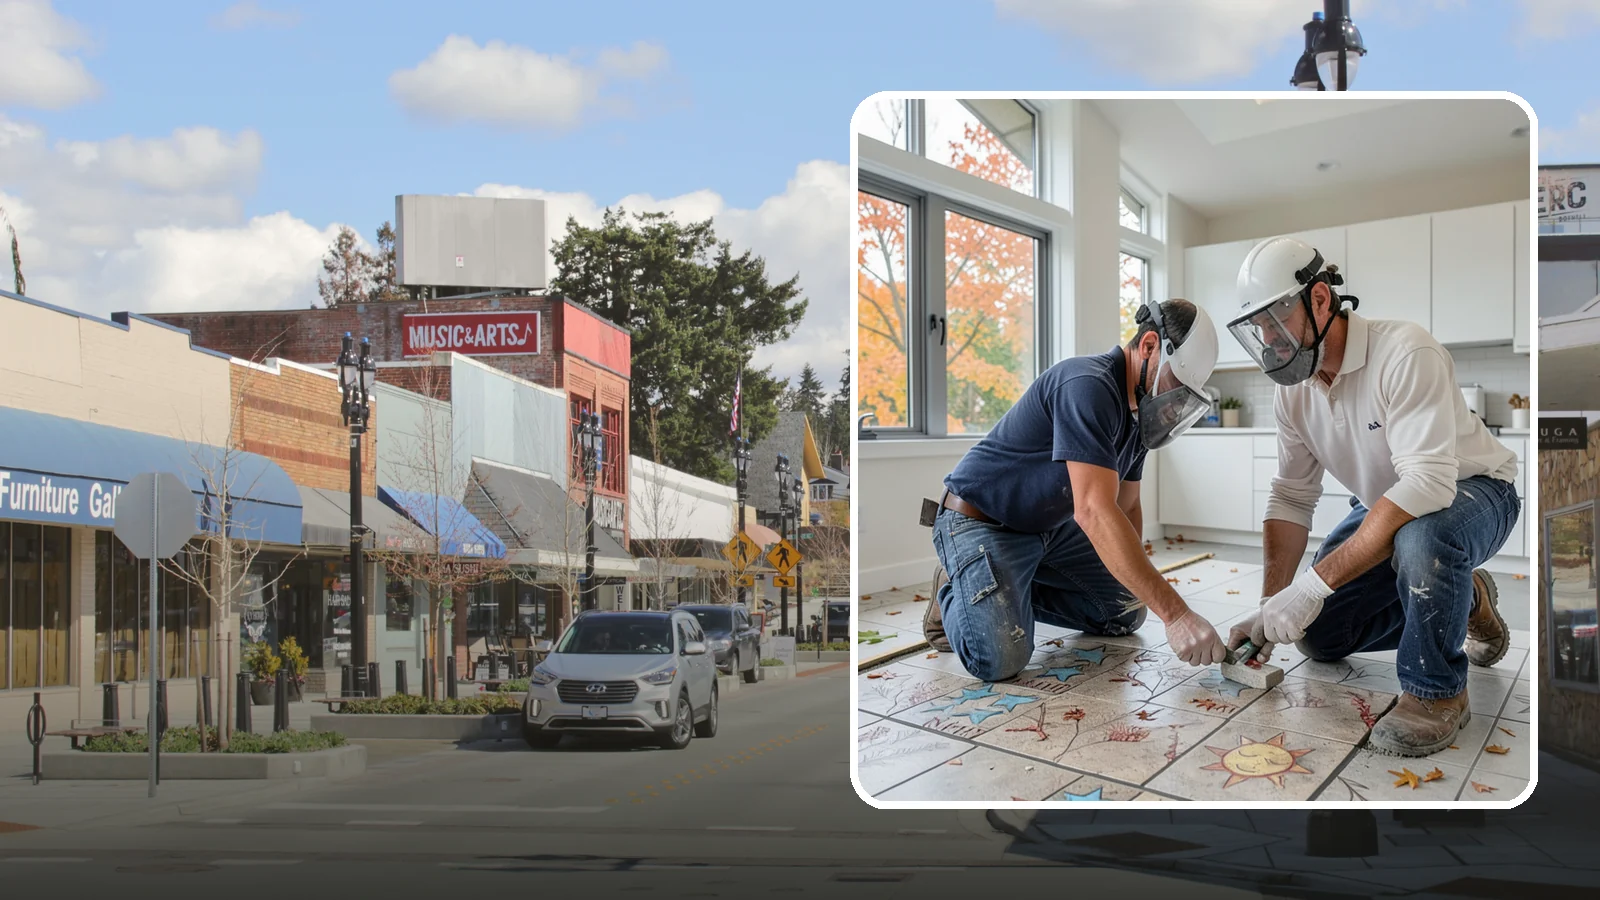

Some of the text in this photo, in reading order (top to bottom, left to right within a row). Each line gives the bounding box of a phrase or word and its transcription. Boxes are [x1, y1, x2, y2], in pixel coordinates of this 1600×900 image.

[409, 323, 519, 348] MUSIC&ARTS
[0, 471, 79, 515] Furniture
[453, 563, 479, 574] SUSHI
